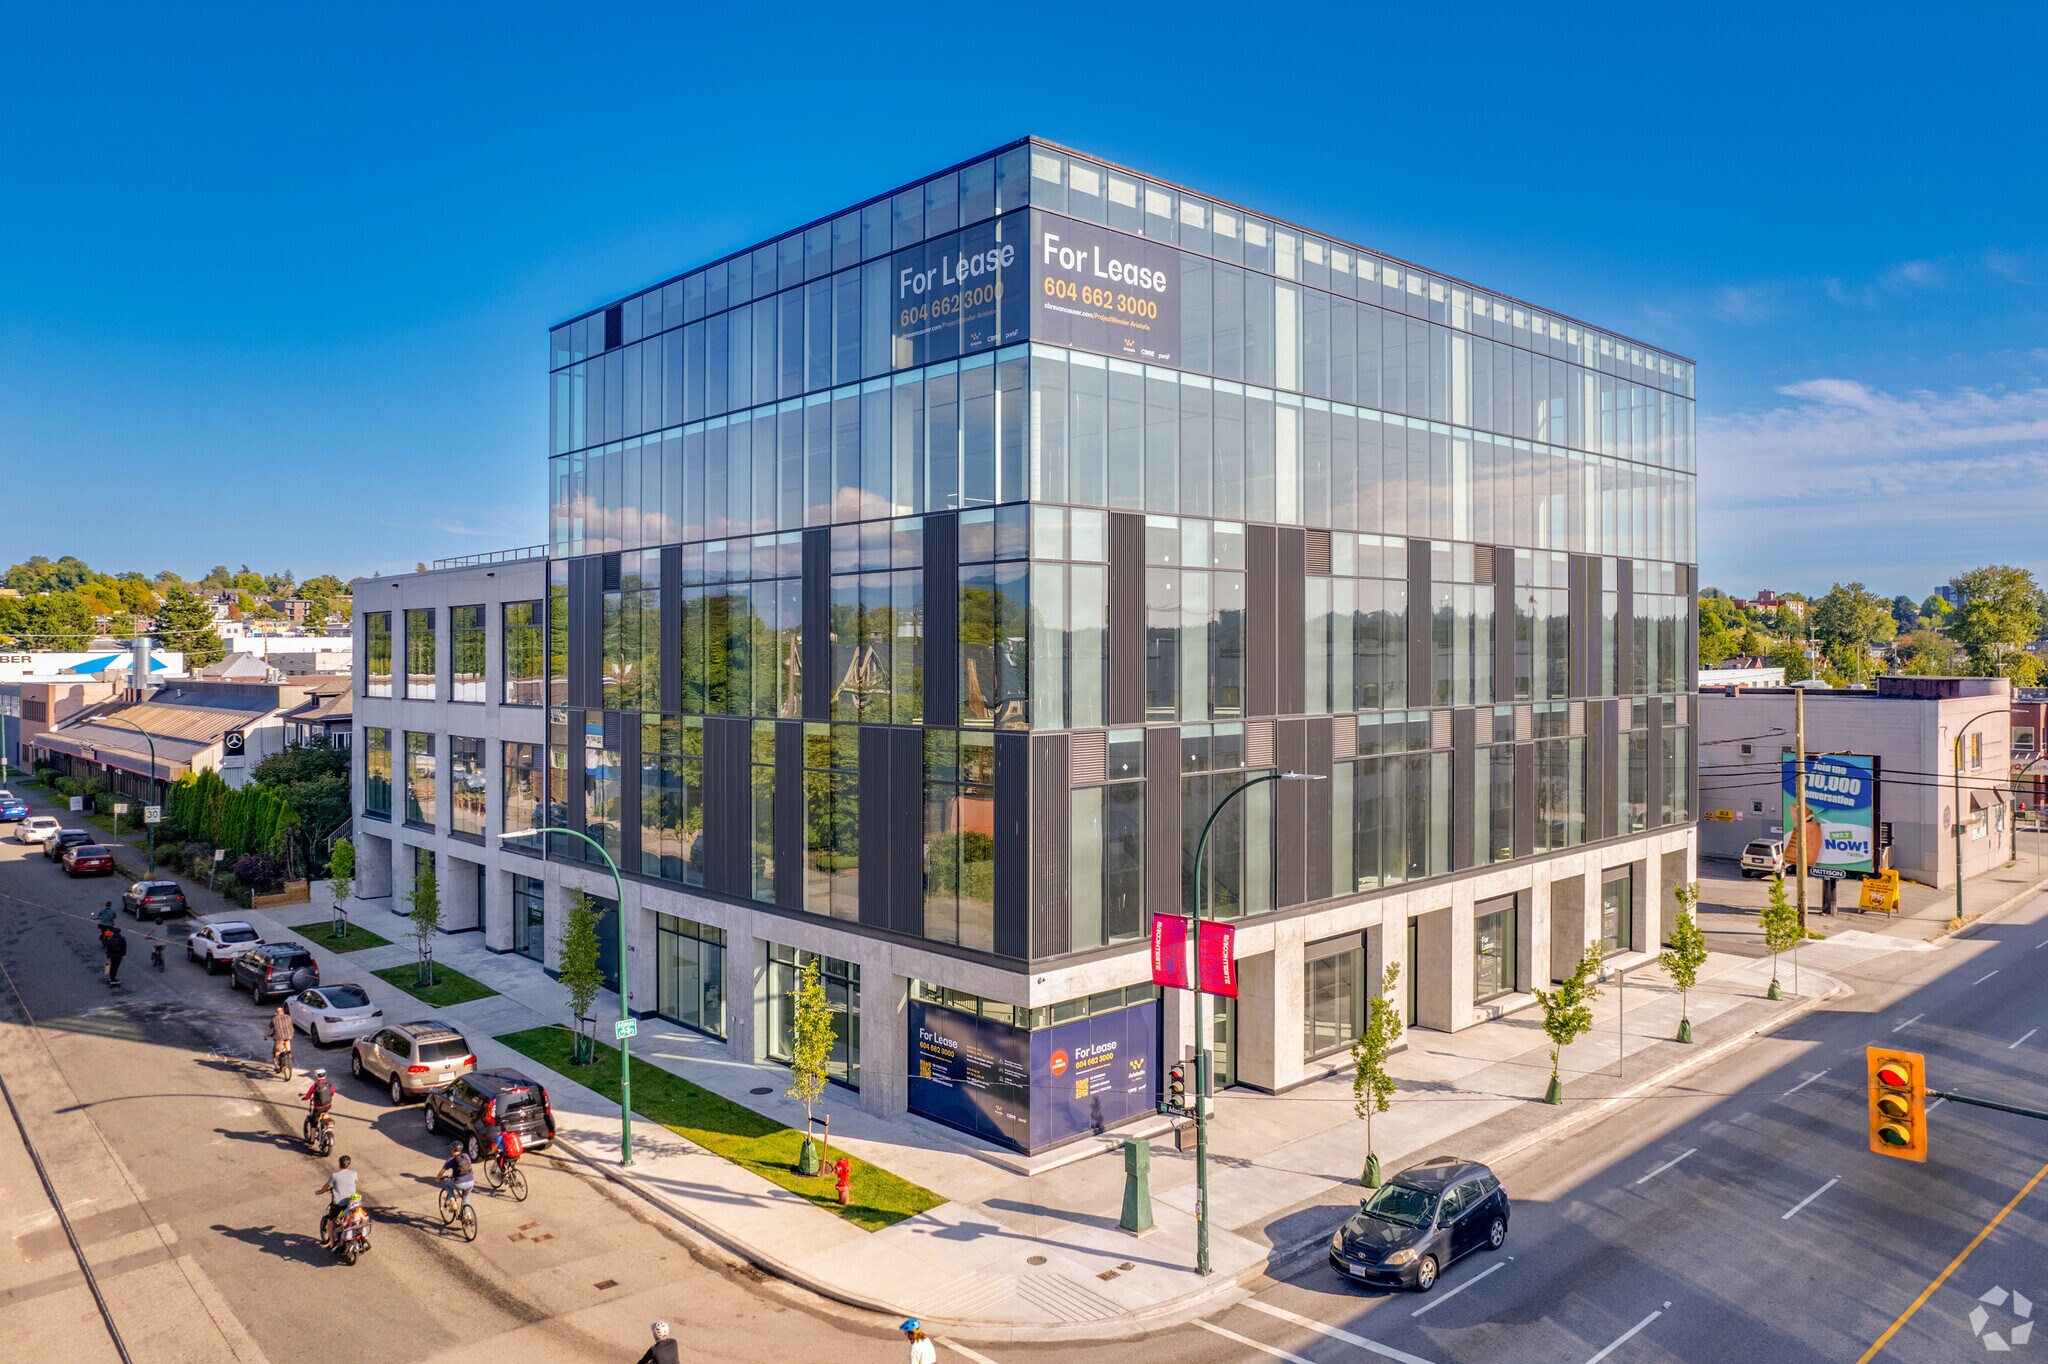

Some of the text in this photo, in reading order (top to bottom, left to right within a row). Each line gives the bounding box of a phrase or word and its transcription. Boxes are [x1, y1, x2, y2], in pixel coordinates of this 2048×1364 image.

[900, 244, 1015, 299] For Lease
[1044, 232, 1167, 293] For Lease
[900, 281, 1004, 327] 604 662 3000
[1044, 276, 1158, 320] 604 662 3000
[1813, 761, 1847, 775] Join the
[1805, 771, 1862, 796] 10,000
[1805, 790, 1855, 807] onversation
[146, 810, 159, 819] 30
[1846, 851, 1865, 859] radio
[1812, 868, 1843, 877] PATTISON
[919, 1027, 958, 1049] For Lease
[919, 1041, 930, 1050] 604
[930, 1045, 941, 1054] 662
[941, 1048, 955, 1058] 3000
[1075, 1041, 1117, 1060] For Lease
[1075, 1060, 1087, 1070] 604
[1087, 1057, 1098, 1066] 662
[1099, 1052, 1114, 1062] 3000
